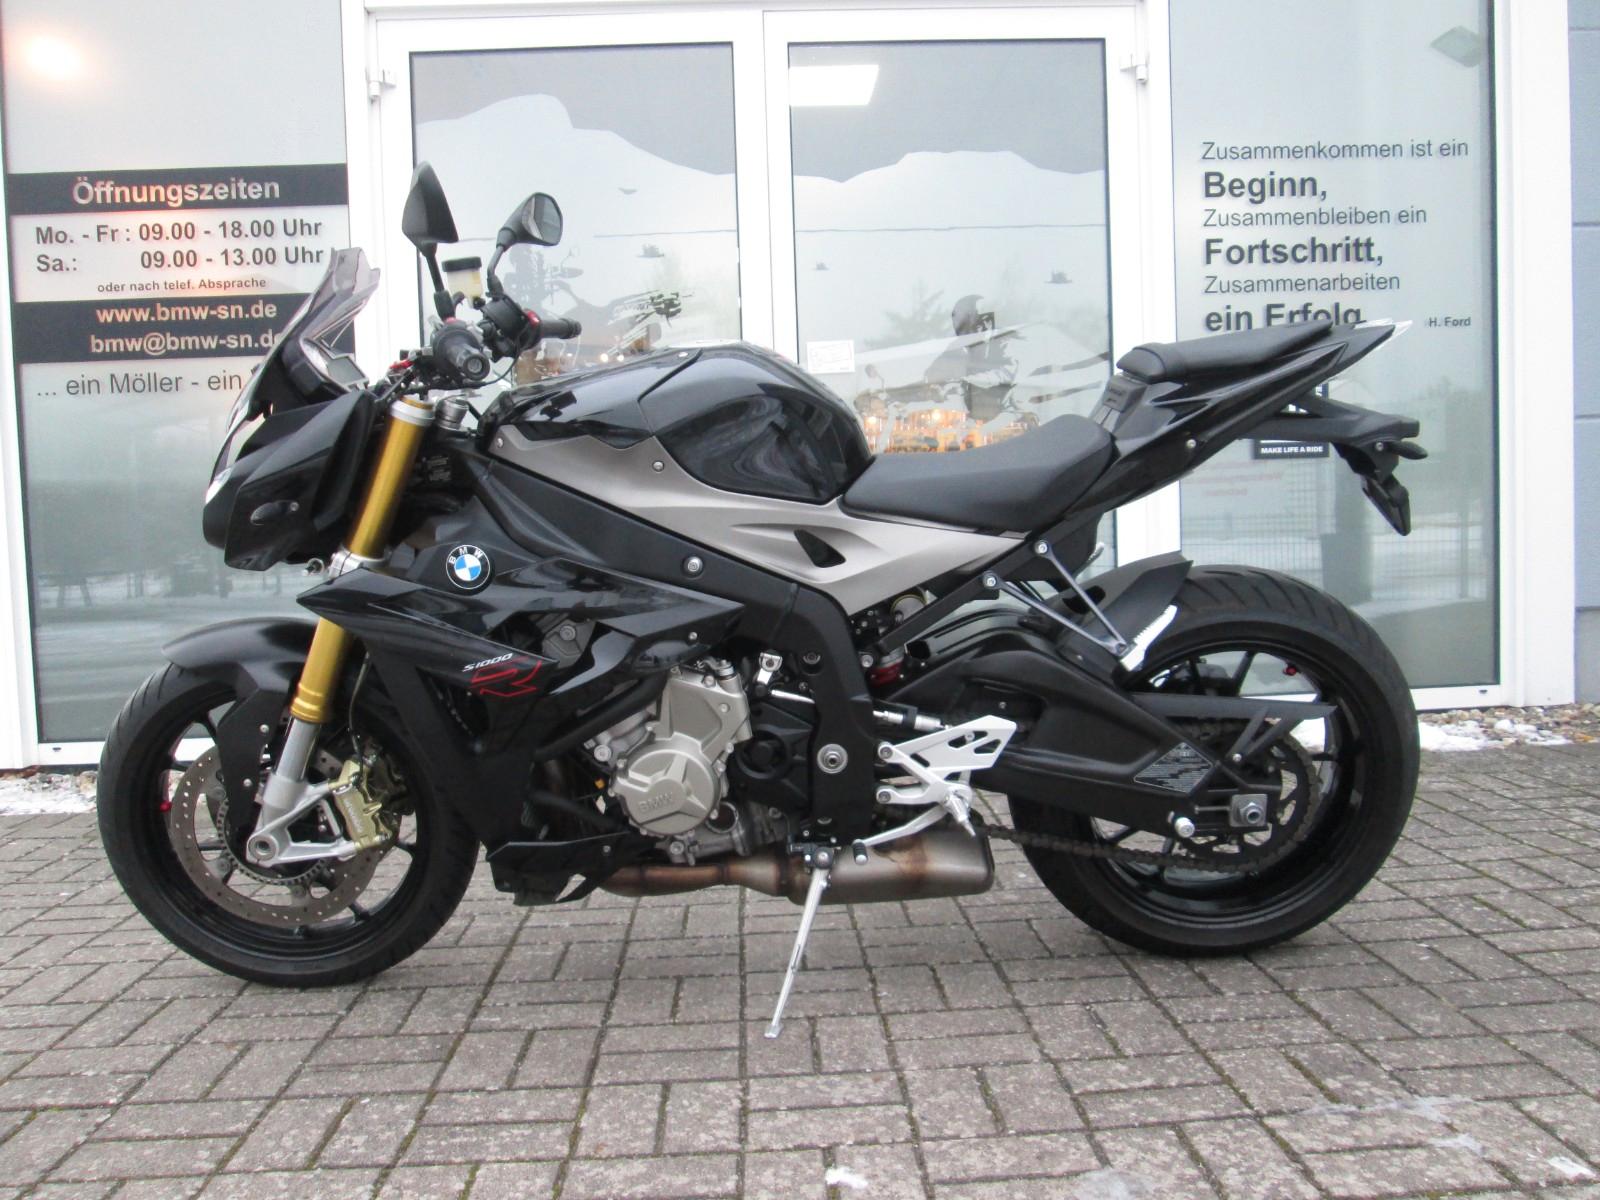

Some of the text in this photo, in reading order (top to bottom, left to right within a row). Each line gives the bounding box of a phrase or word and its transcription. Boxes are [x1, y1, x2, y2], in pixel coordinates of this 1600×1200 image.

[1201, 138, 1469, 160] Zusammenkommen ist ein
[72, 177, 280, 207] Öffnungszeiten
[1203, 170, 1327, 205] Beginn,
[1202, 206, 1427, 227] Zusammenbleiben ein
[35, 226, 75, 245] Mo.
[139, 222, 196, 241] 09.00
[218, 220, 275, 239] 18.00
[283, 219, 322, 237] Uhr
[36, 254, 78, 273] Sa.:
[140, 249, 198, 269] 09.00
[220, 247, 277, 267] 13.00
[285, 246, 323, 264] Uhr
[1204, 236, 1383, 266] Fortschritt,
[97, 277, 267, 293] oder nach telef. Absprache
[1203, 273, 1400, 294] Zusammenarbeiten
[96, 300, 278, 323] www.bmw-sn.de
[1205, 305, 1253, 331] ein
[1428, 317, 1471, 327] H. Ford
[66, 374, 101, 395] ein
[110, 372, 183, 394] Möller
[208, 370, 242, 391] ein
[449, 547, 484, 564] BMW
[462, 652, 514, 672] S1000
